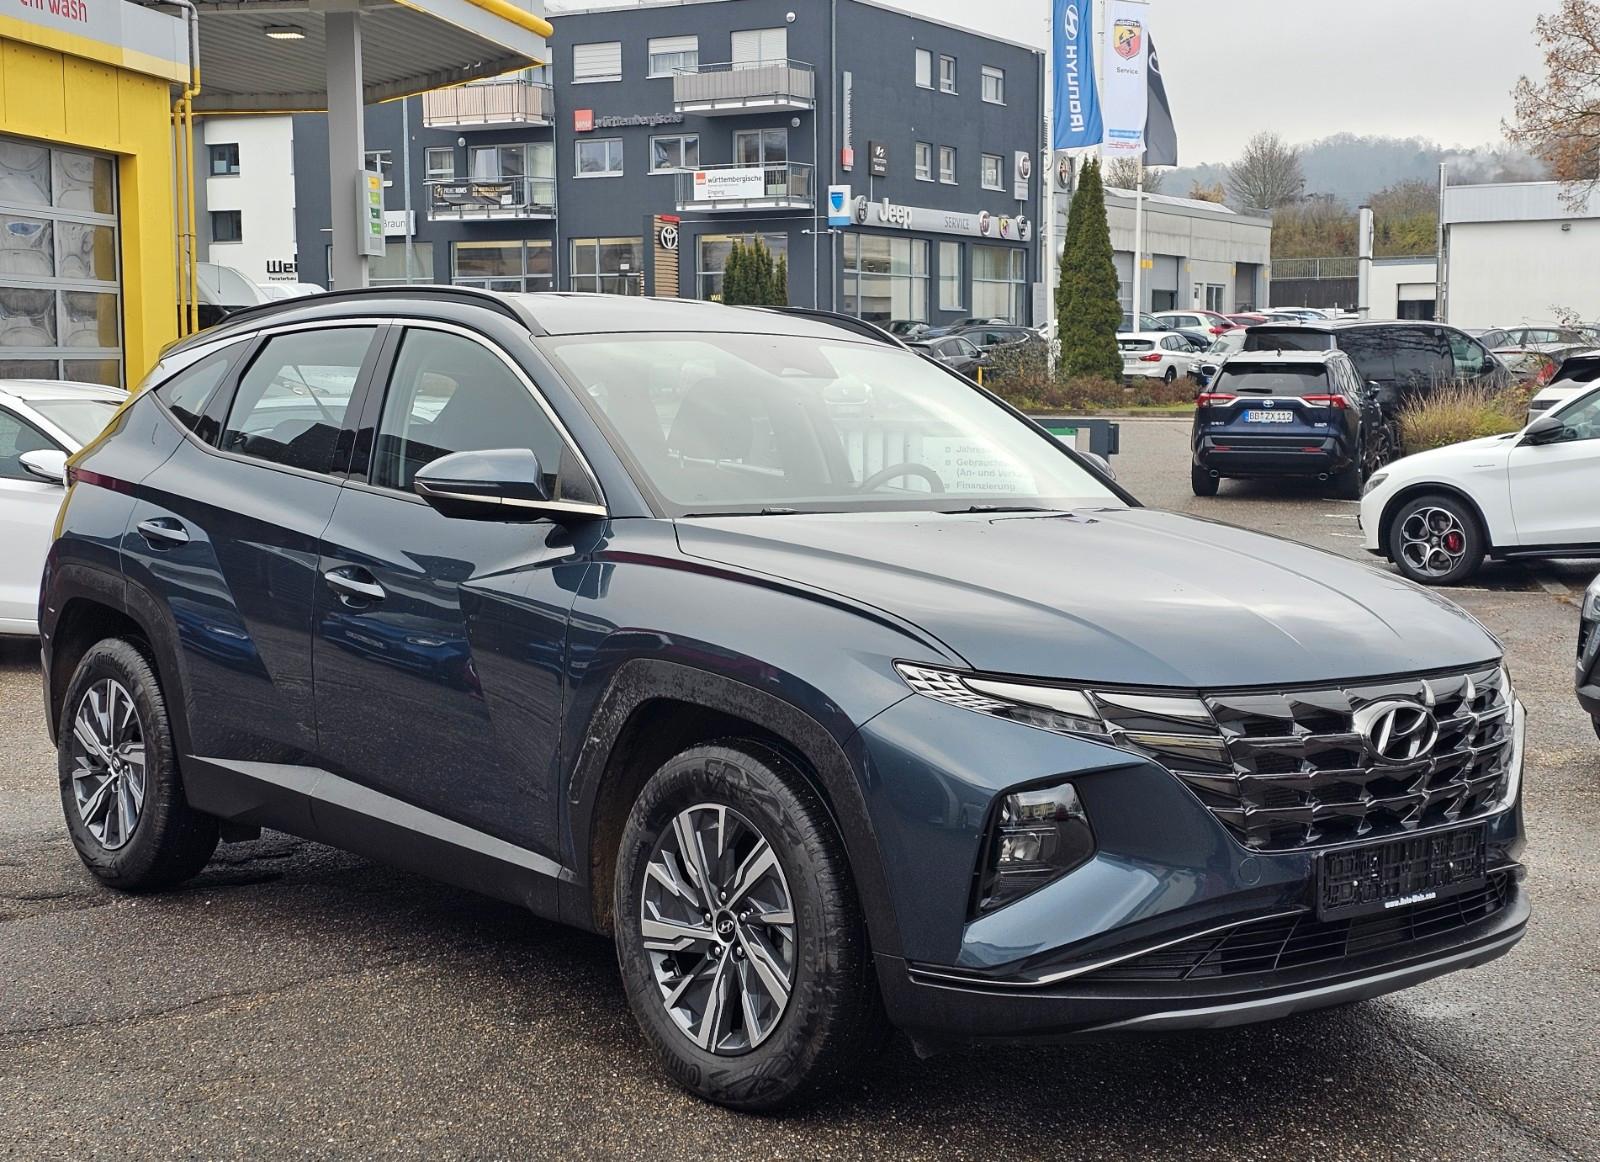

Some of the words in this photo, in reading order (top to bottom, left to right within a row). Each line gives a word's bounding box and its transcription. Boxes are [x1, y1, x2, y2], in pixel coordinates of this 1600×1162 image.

[48, 0, 88, 23] wash
[1116, 66, 1140, 75] Service
[1066, 45, 1085, 132] HYUNDAI
[707, 174, 763, 184] württembergische
[879, 197, 913, 230] Jeep
[944, 216, 970, 231] SERVICE
[956, 480, 1017, 492] Finanzierung
